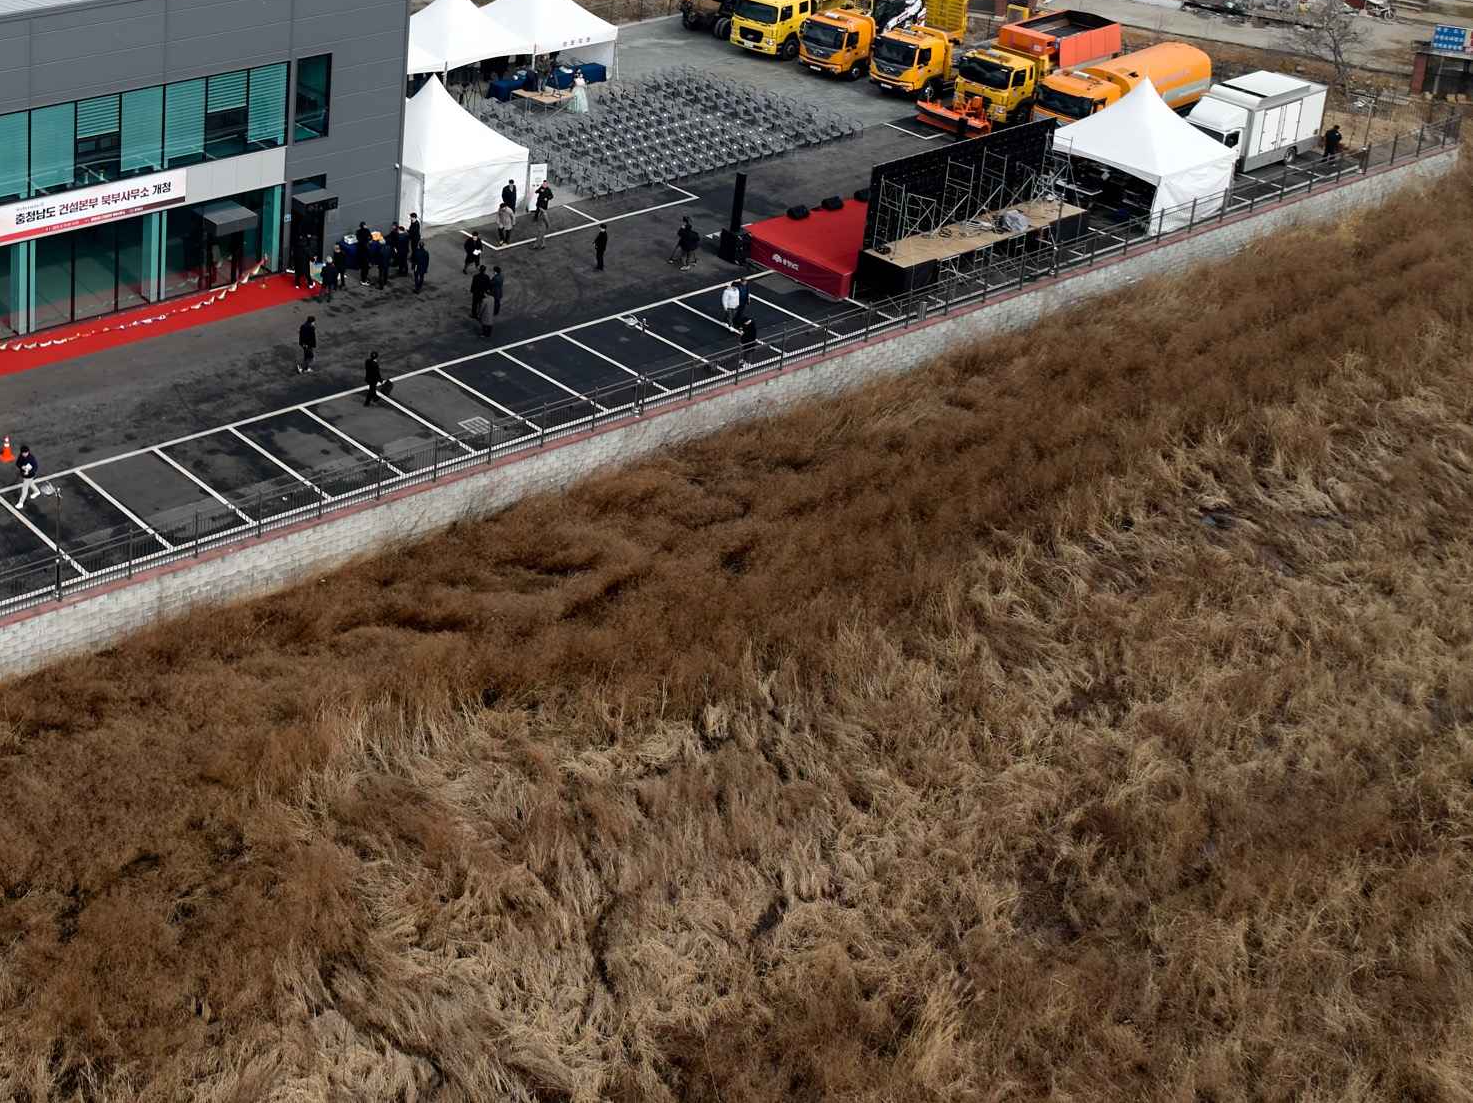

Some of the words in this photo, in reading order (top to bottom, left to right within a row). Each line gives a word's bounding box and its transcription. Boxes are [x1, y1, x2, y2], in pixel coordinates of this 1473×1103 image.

[15, 206, 56, 225] 충청남도
[59, 198, 99, 216] 건설본부
[101, 188, 150, 207] 북부사무소
[152, 181, 172, 195] 개청
